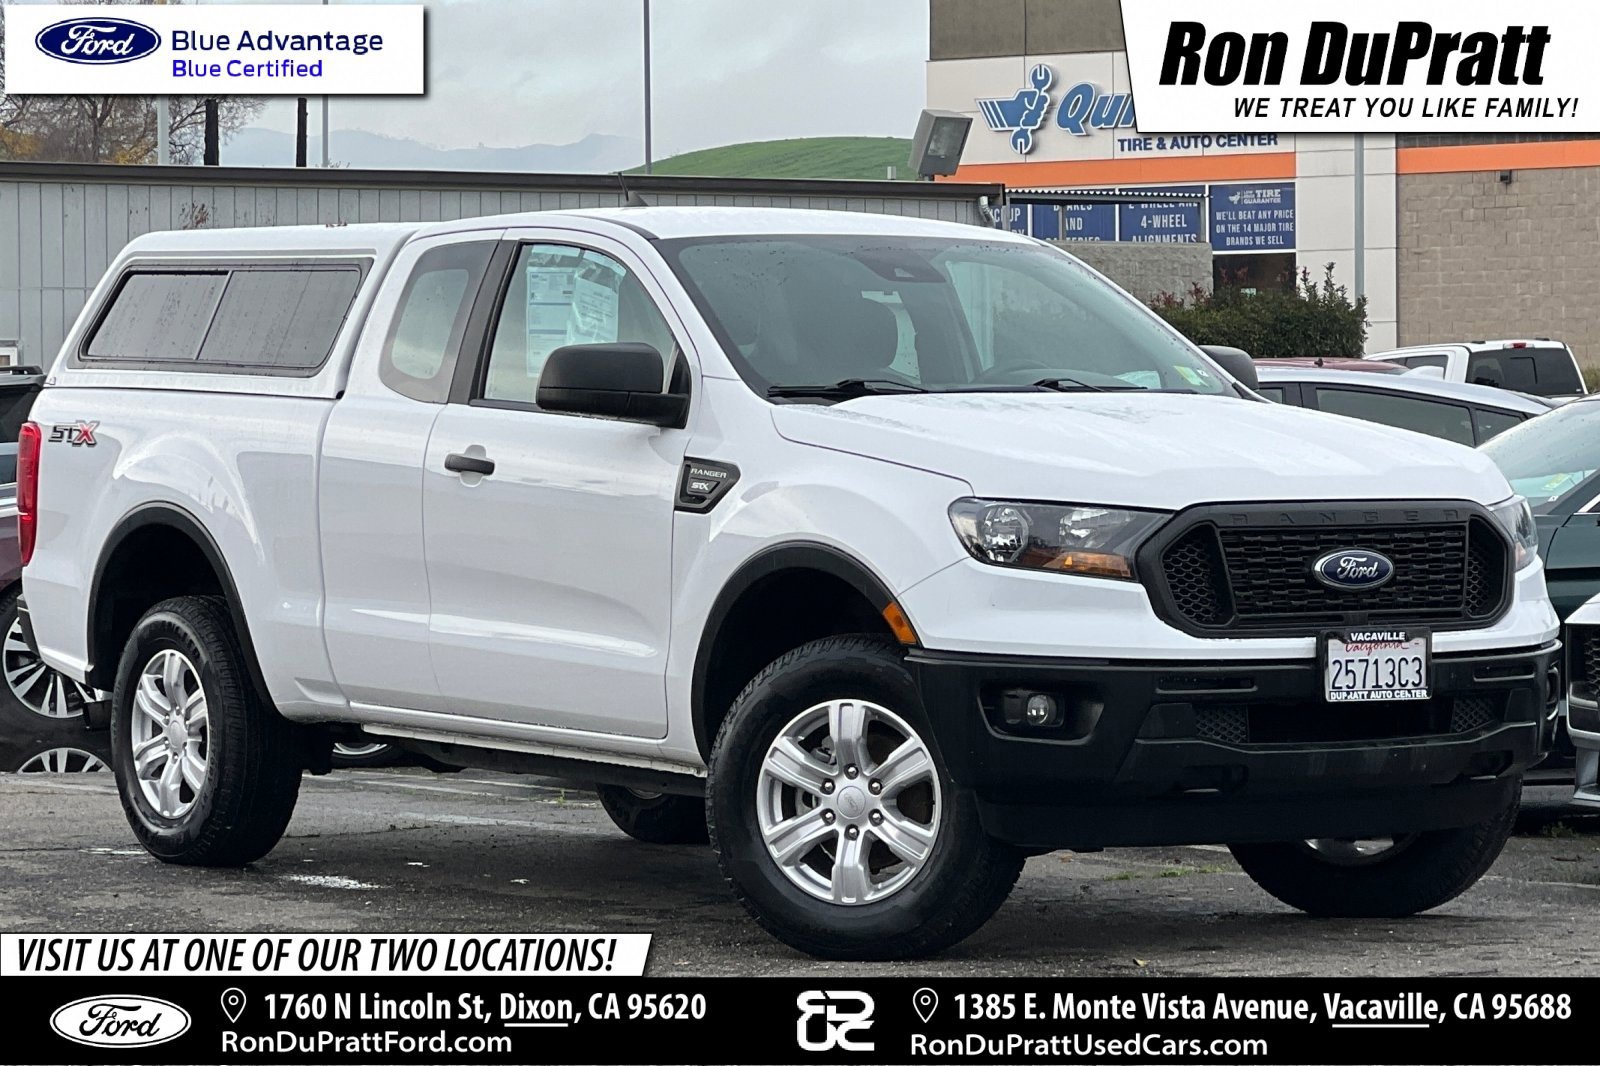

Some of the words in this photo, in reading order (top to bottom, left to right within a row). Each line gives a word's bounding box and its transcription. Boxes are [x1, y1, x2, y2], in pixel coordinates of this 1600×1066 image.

[1117, 137, 1154, 151] TIRE
[1156, 138, 1168, 150] &
[1170, 135, 1213, 150] AUTO
[1215, 134, 1278, 148] CENTER
[1255, 188, 1281, 198] TIRE
[1215, 211, 1236, 221] WE'LL
[1238, 210, 1256, 220] BEAT
[1257, 210, 1272, 219] ANY
[1273, 209, 1294, 219] PRICE
[1140, 214, 1188, 229] 4-WHEEL
[1215, 224, 1226, 234] ON
[1227, 224, 1241, 233] THE
[1243, 223, 1252, 233] 14
[1253, 223, 1277, 233] MAJOR
[1278, 222, 1294, 232] TIRE
[1226, 236, 1254, 246] BRANDS
[1255, 236, 1266, 245] WE
[1267, 235, 1284, 245] SELL
[48, 420, 100, 447] STX
[690, 467, 727, 479] RANGER
[691, 481, 709, 491] STX
[1228, 509, 1459, 526] RANGER
[1337, 556, 1379, 579] Ford
[1350, 632, 1406, 641] VACAVILLE
[1331, 656, 1423, 690] 25713C3
[1370, 690, 1393, 699] AUTO
